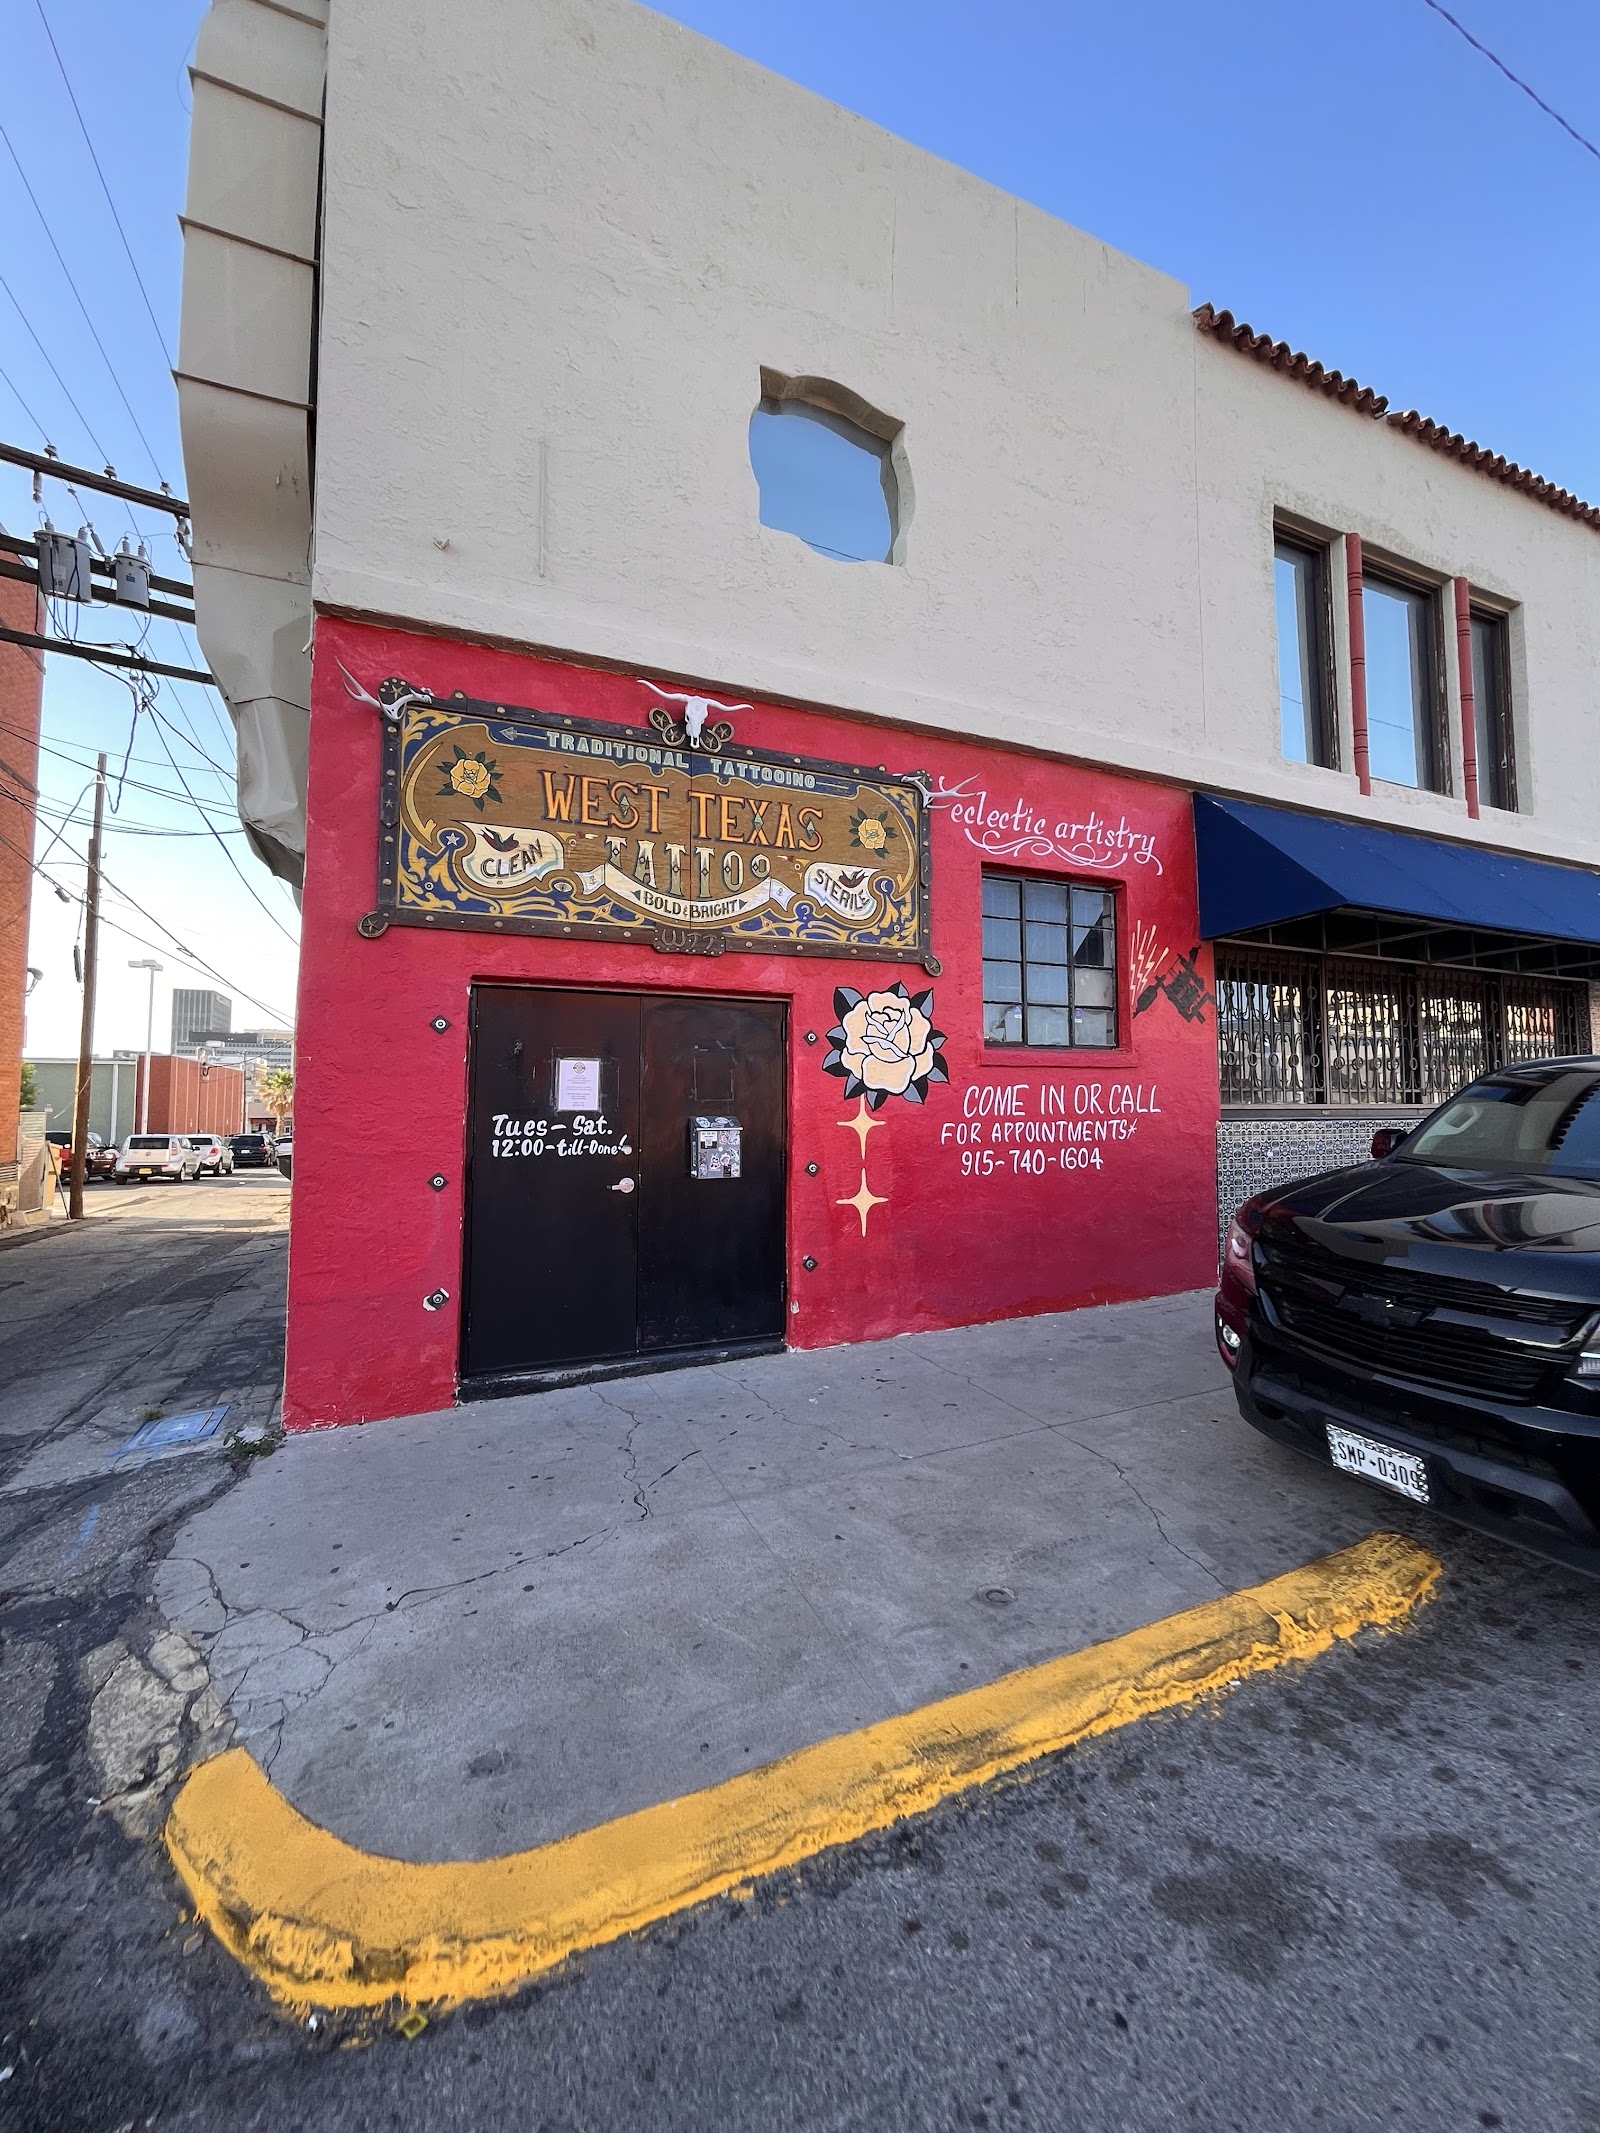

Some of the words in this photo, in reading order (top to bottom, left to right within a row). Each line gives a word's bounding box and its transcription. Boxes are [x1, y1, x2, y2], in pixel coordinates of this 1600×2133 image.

[546, 731, 690, 769] TRADITIONAL
[710, 758, 816, 789] TATTOOING
[538, 769, 670, 835] WEST
[688, 789, 824, 852] TEXAS
[950, 791, 1045, 836] eclectic
[1054, 811, 1164, 876] artistry
[481, 838, 543, 879] CLEAN
[605, 835, 772, 899] TATTOO
[643, 889, 681, 916] BOLD
[690, 899, 738, 920] BRIGHT
[815, 868, 872, 913] STERILE
[963, 1084, 1029, 1119] COME
[1040, 1084, 1066, 1115] IN
[1074, 1083, 1105, 1115] OR
[1109, 1084, 1162, 1115] CALL
[572, 1115, 613, 1136] Sat.
[941, 1121, 982, 1146] FOR
